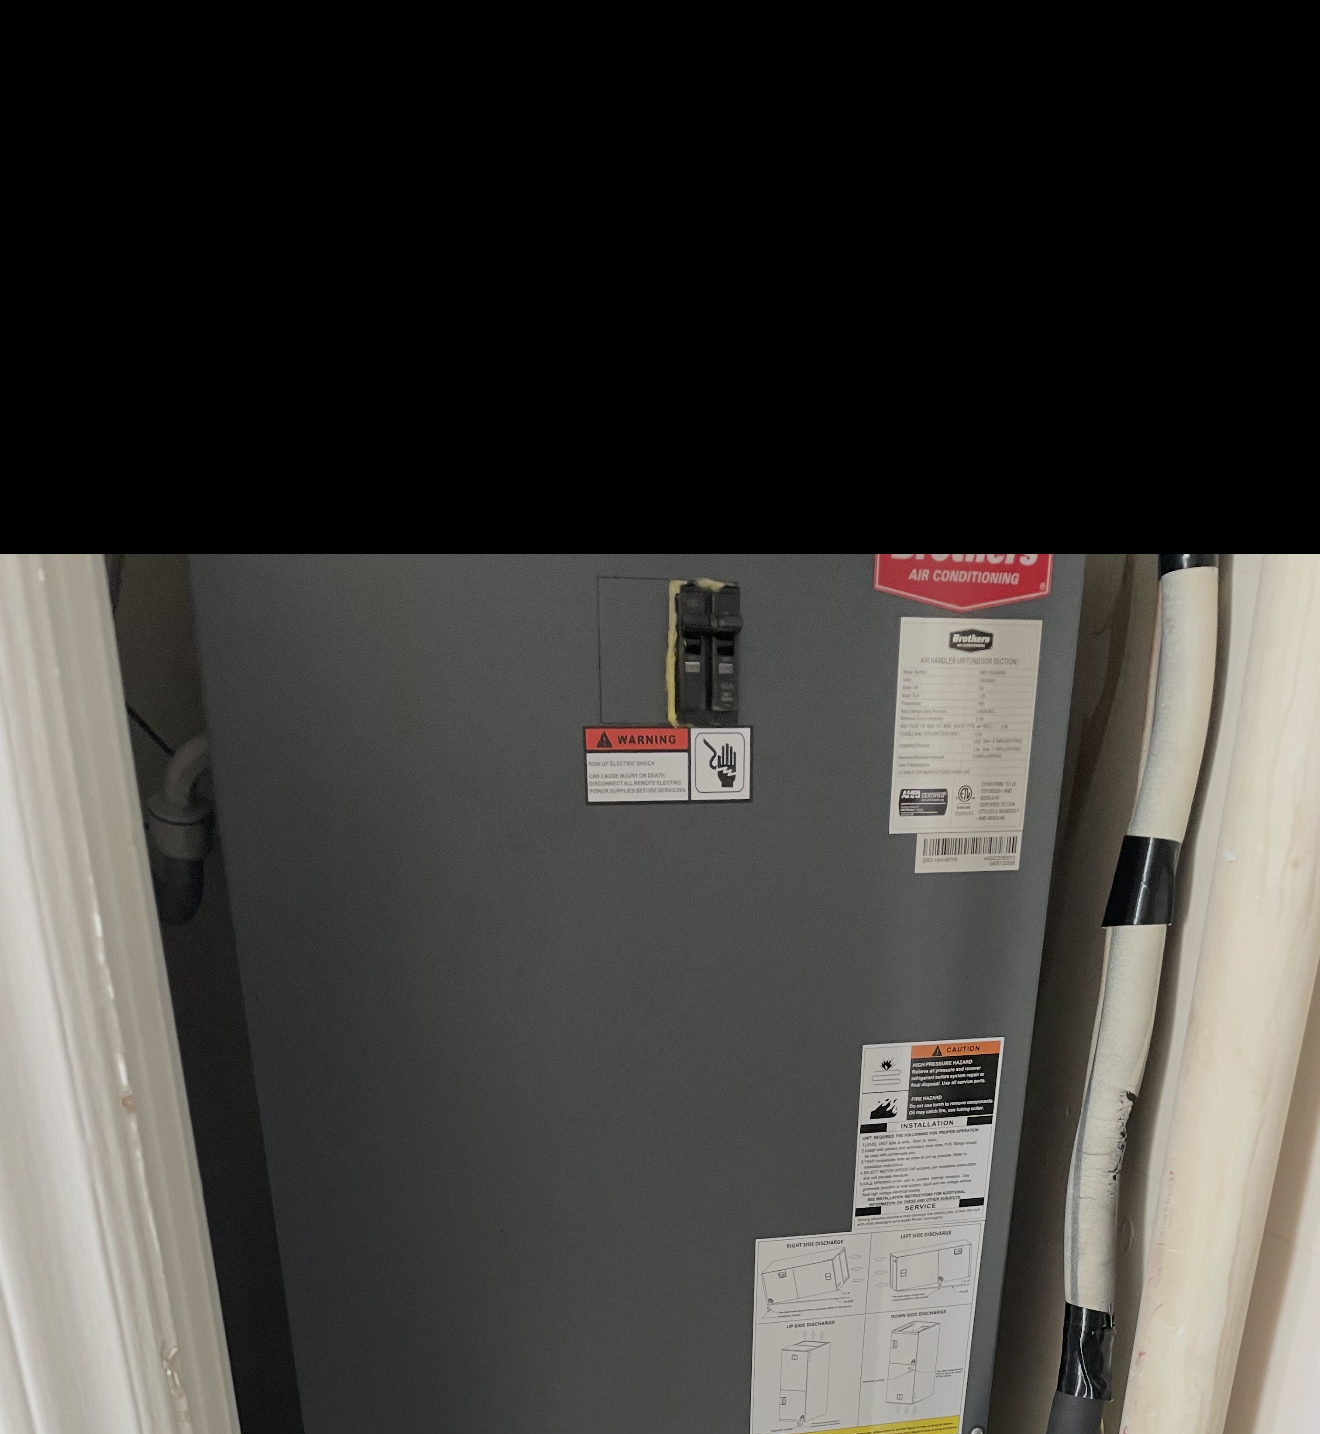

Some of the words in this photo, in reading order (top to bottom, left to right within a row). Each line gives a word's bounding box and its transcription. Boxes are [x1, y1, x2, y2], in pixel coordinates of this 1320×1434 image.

[908, 569, 930, 581] AIR
[933, 570, 1020, 585] CONDITIONING
[952, 633, 990, 643] Brothers
[618, 735, 677, 745] WARNING
[901, 1120, 954, 1129] INSTALLATION
